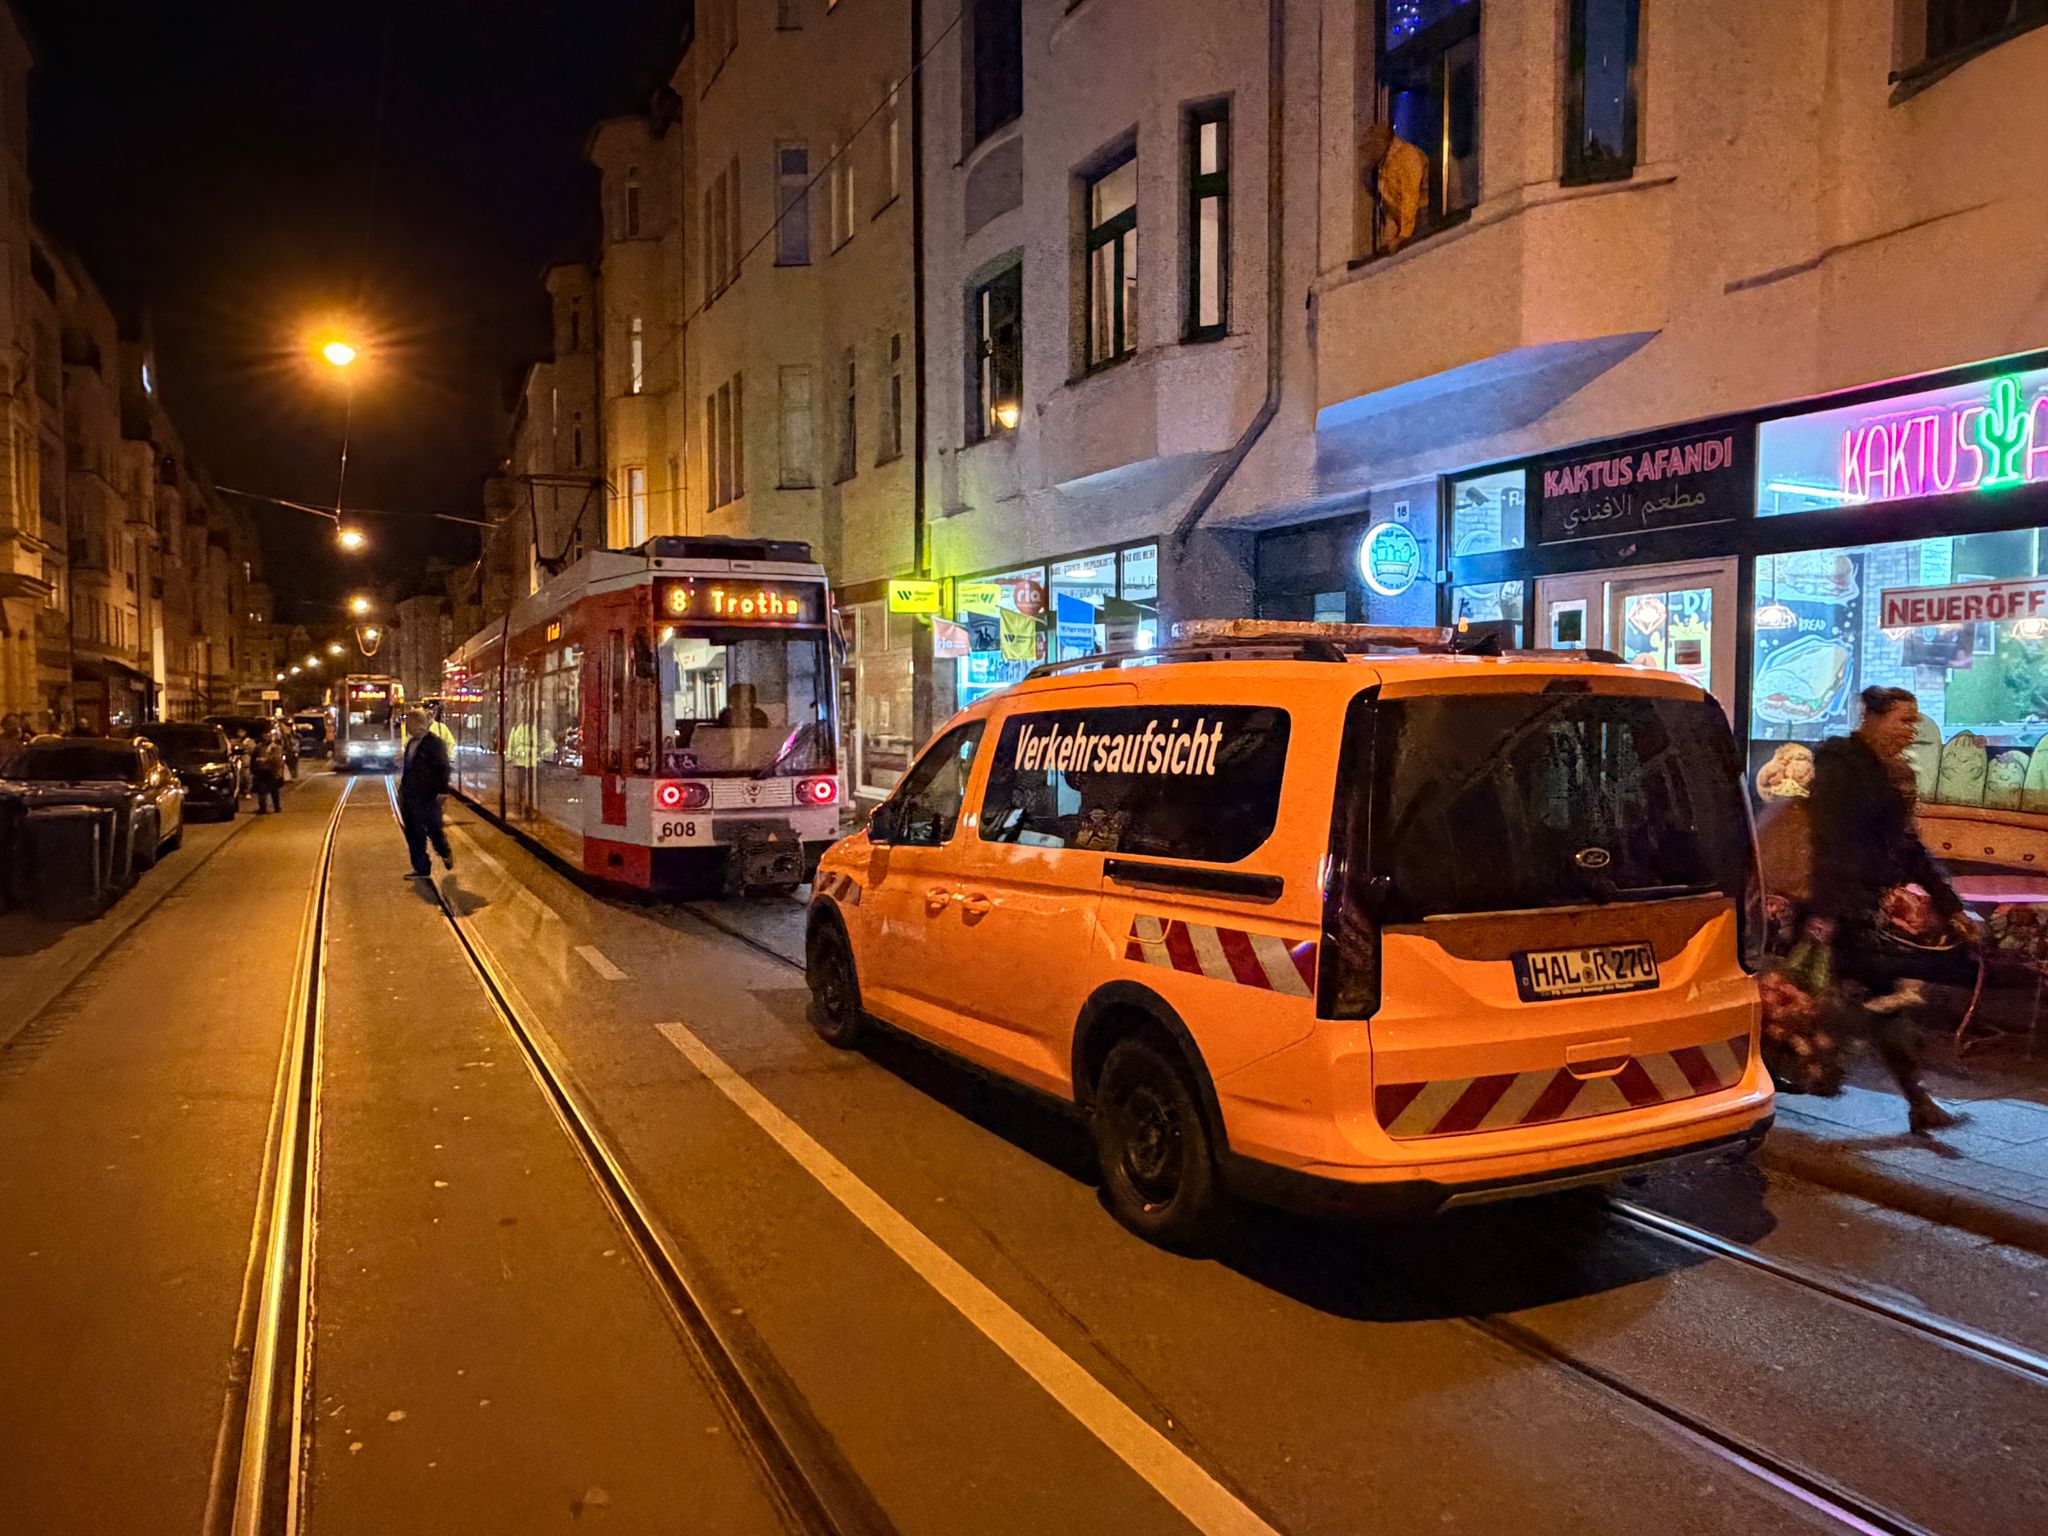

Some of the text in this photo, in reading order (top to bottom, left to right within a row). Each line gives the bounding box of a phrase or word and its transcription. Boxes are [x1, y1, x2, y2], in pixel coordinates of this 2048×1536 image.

[1544, 436, 1733, 499] KAKTUS AFANDI
[1844, 406, 1983, 502] KAKTUS
[1396, 505, 1408, 518] 18
[1641, 483, 1706, 524] مطعم
[672, 589, 798, 615] 8 Trotha
[1798, 617, 1827, 632] BREAD
[1014, 718, 1224, 776] Verkehrsaufsicht
[662, 821, 696, 838] 608
[1531, 947, 1653, 988] HAL R 270
